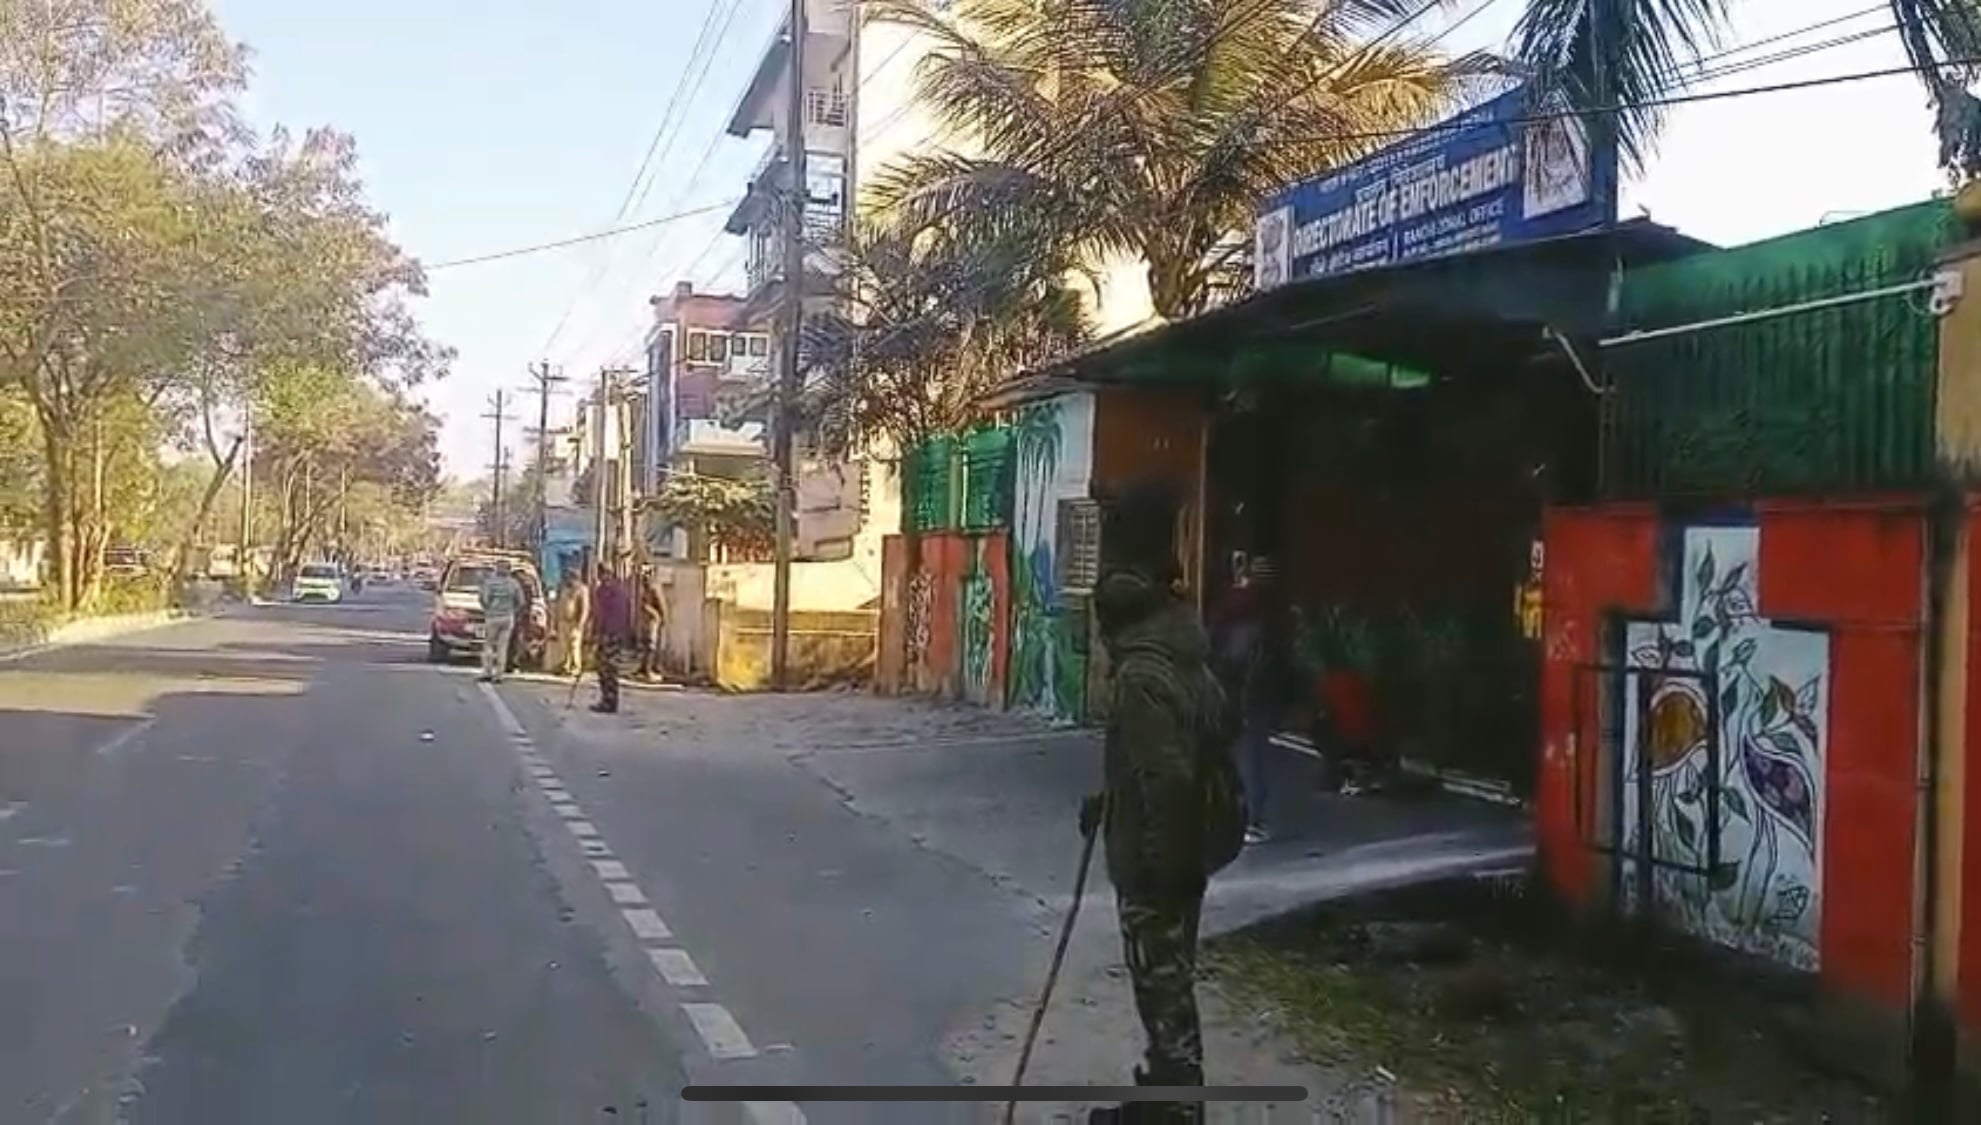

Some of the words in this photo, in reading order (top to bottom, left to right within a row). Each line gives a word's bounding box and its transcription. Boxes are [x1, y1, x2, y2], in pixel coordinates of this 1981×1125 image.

[1293, 199, 1377, 258] DIRECTORATE
[1378, 186, 1400, 228] OF
[1401, 143, 1518, 220] ENFORCEMENT
[1469, 197, 1504, 223] OFFICE
